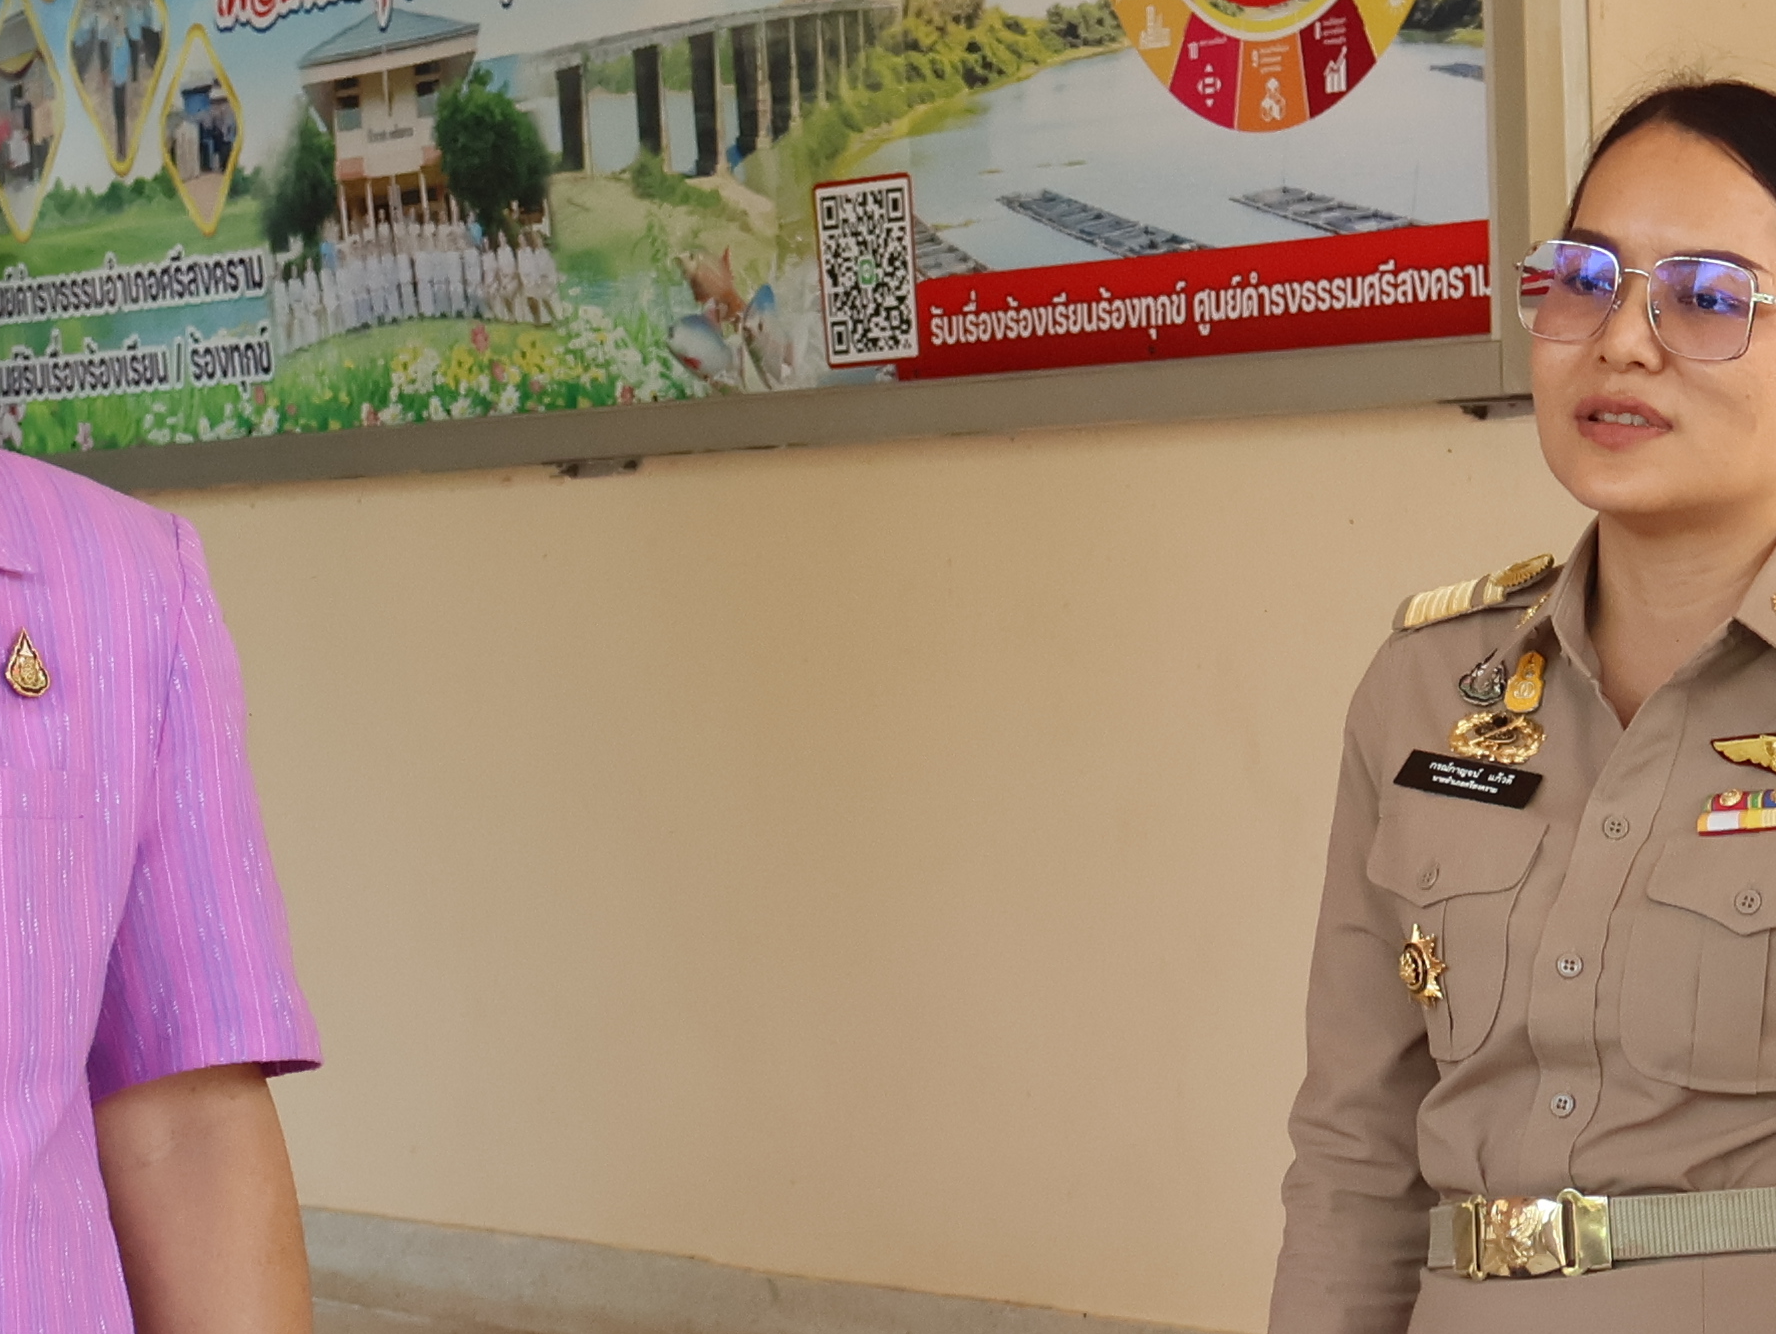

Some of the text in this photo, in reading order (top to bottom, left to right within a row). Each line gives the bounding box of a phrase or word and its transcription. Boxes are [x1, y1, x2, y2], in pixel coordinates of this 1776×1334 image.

[929, 281, 1188, 346] รับเรื่องร้องเรียนร้องทุกข์
[190, 326, 273, 394] ร้องทุกข์
